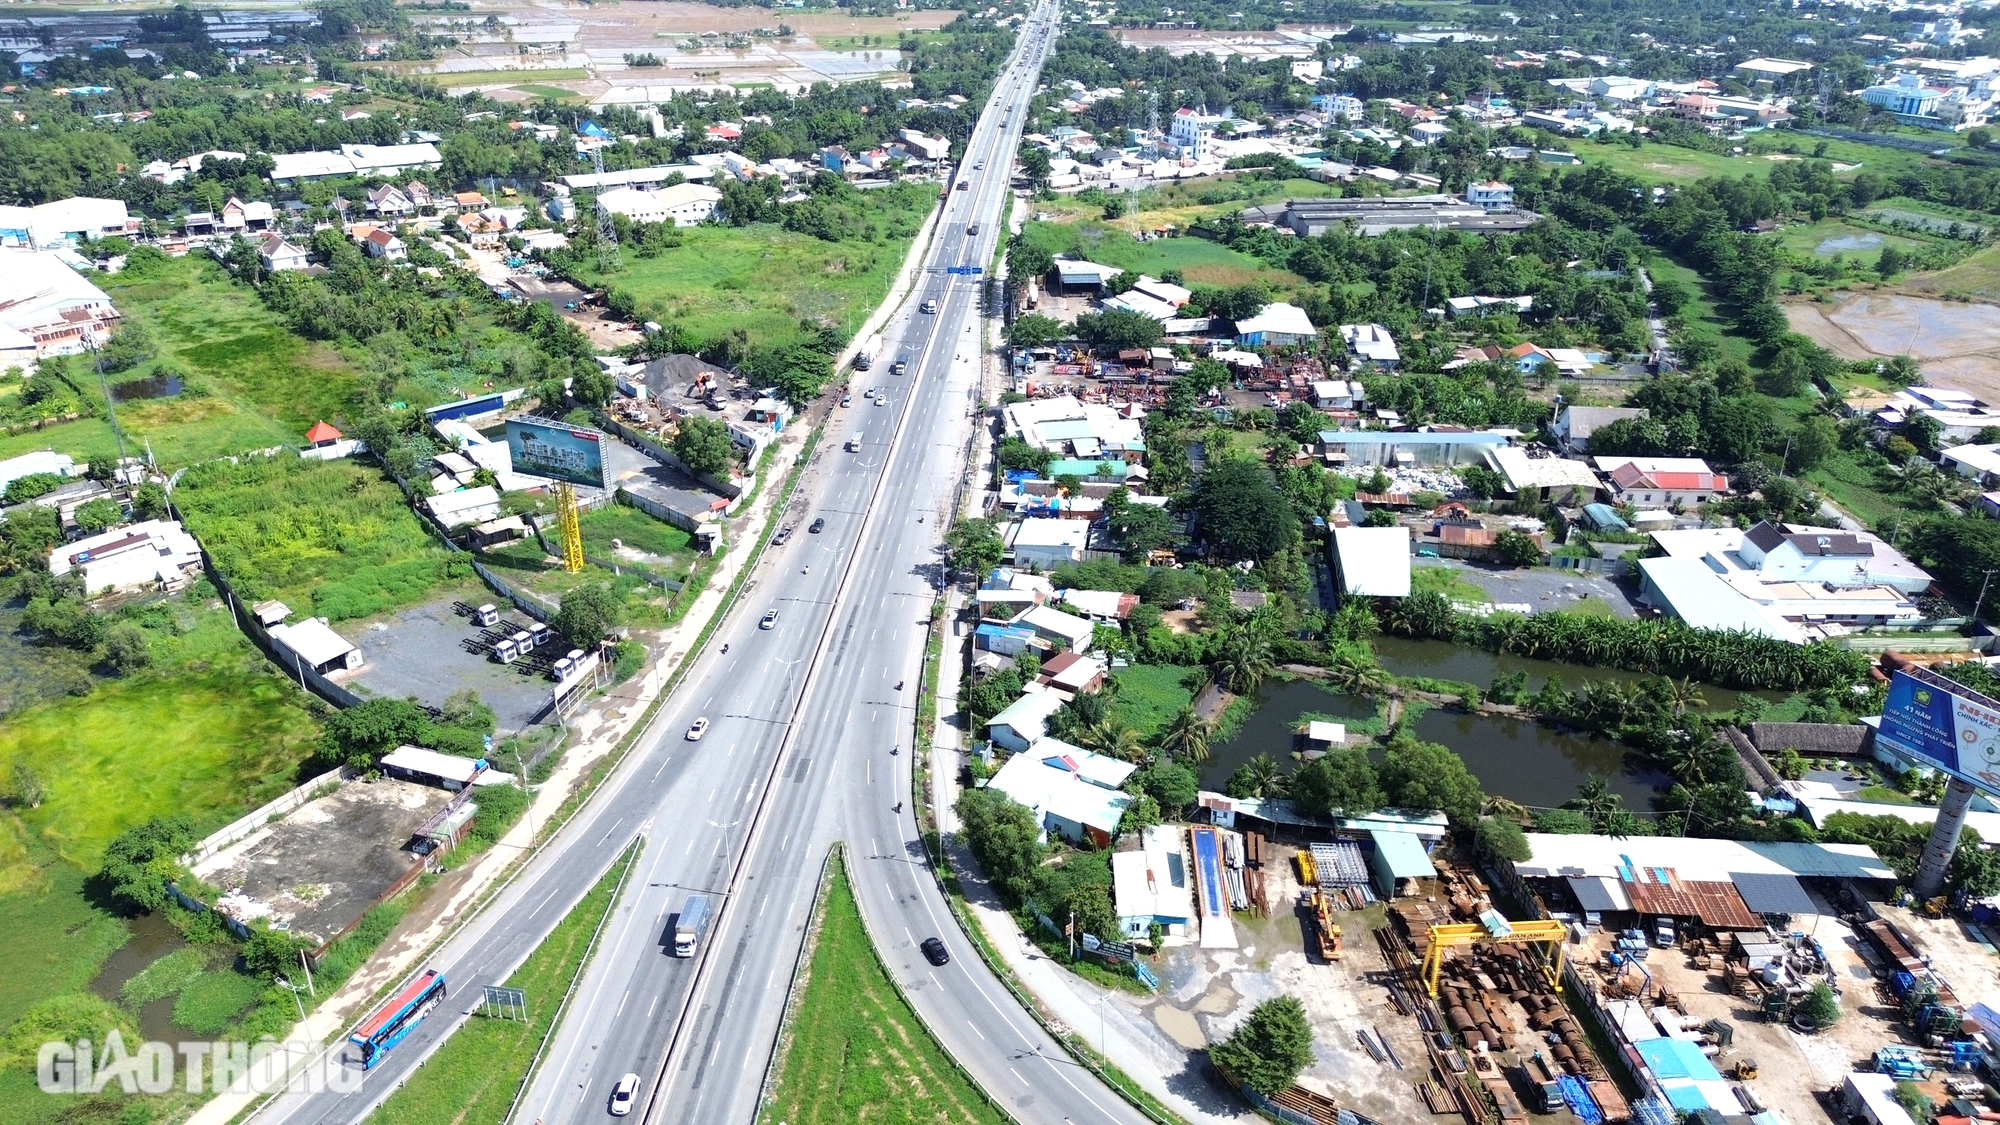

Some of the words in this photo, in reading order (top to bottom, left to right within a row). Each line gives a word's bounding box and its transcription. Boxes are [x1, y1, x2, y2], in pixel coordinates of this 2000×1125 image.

[1904, 705, 1913, 713] 41
[1914, 709, 1932, 720] NĂM
[1957, 711, 1978, 723] CHÍNH
[1979, 720, 1992, 730] XÁC
[1883, 714, 1902, 726] KHÔNG
[1924, 732, 1938, 741] PHÁT
[1940, 738, 1956, 749] TRIỂN
[1889, 708, 1900, 716] TIẾP
[1900, 714, 1911, 722] NỐI
[1912, 718, 1930, 730] THÀNH
[1931, 726, 1947, 737] CÔNG
[1896, 731, 1911, 740] SINCE
[1912, 736, 1925, 746] 1983
